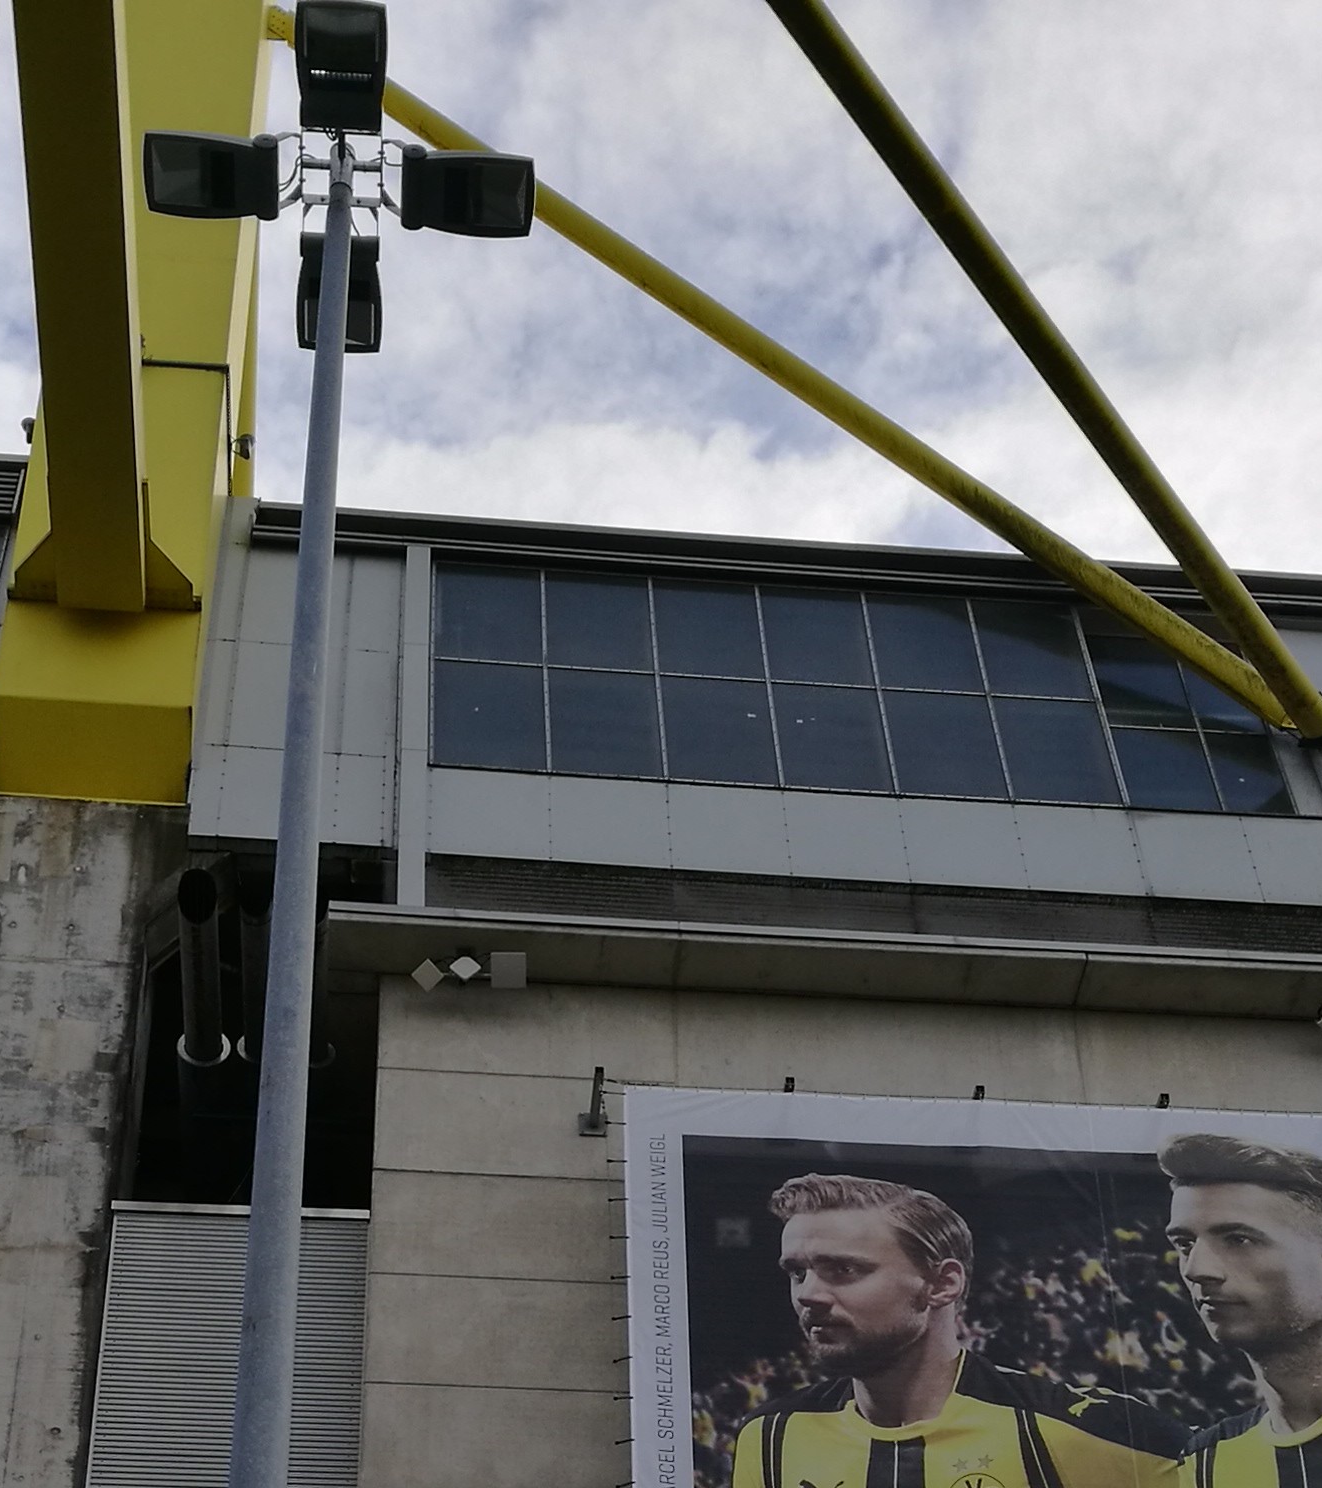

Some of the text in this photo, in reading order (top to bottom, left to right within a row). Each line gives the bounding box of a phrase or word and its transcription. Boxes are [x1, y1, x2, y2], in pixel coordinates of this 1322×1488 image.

[650, 1133, 667, 1177] WEIGL
[652, 1181, 669, 1234] JULIAN
[652, 1236, 670, 1281] REUS,
[654, 1284, 671, 1339] MARCO
[657, 1341, 676, 1440] SCHMELZER,
